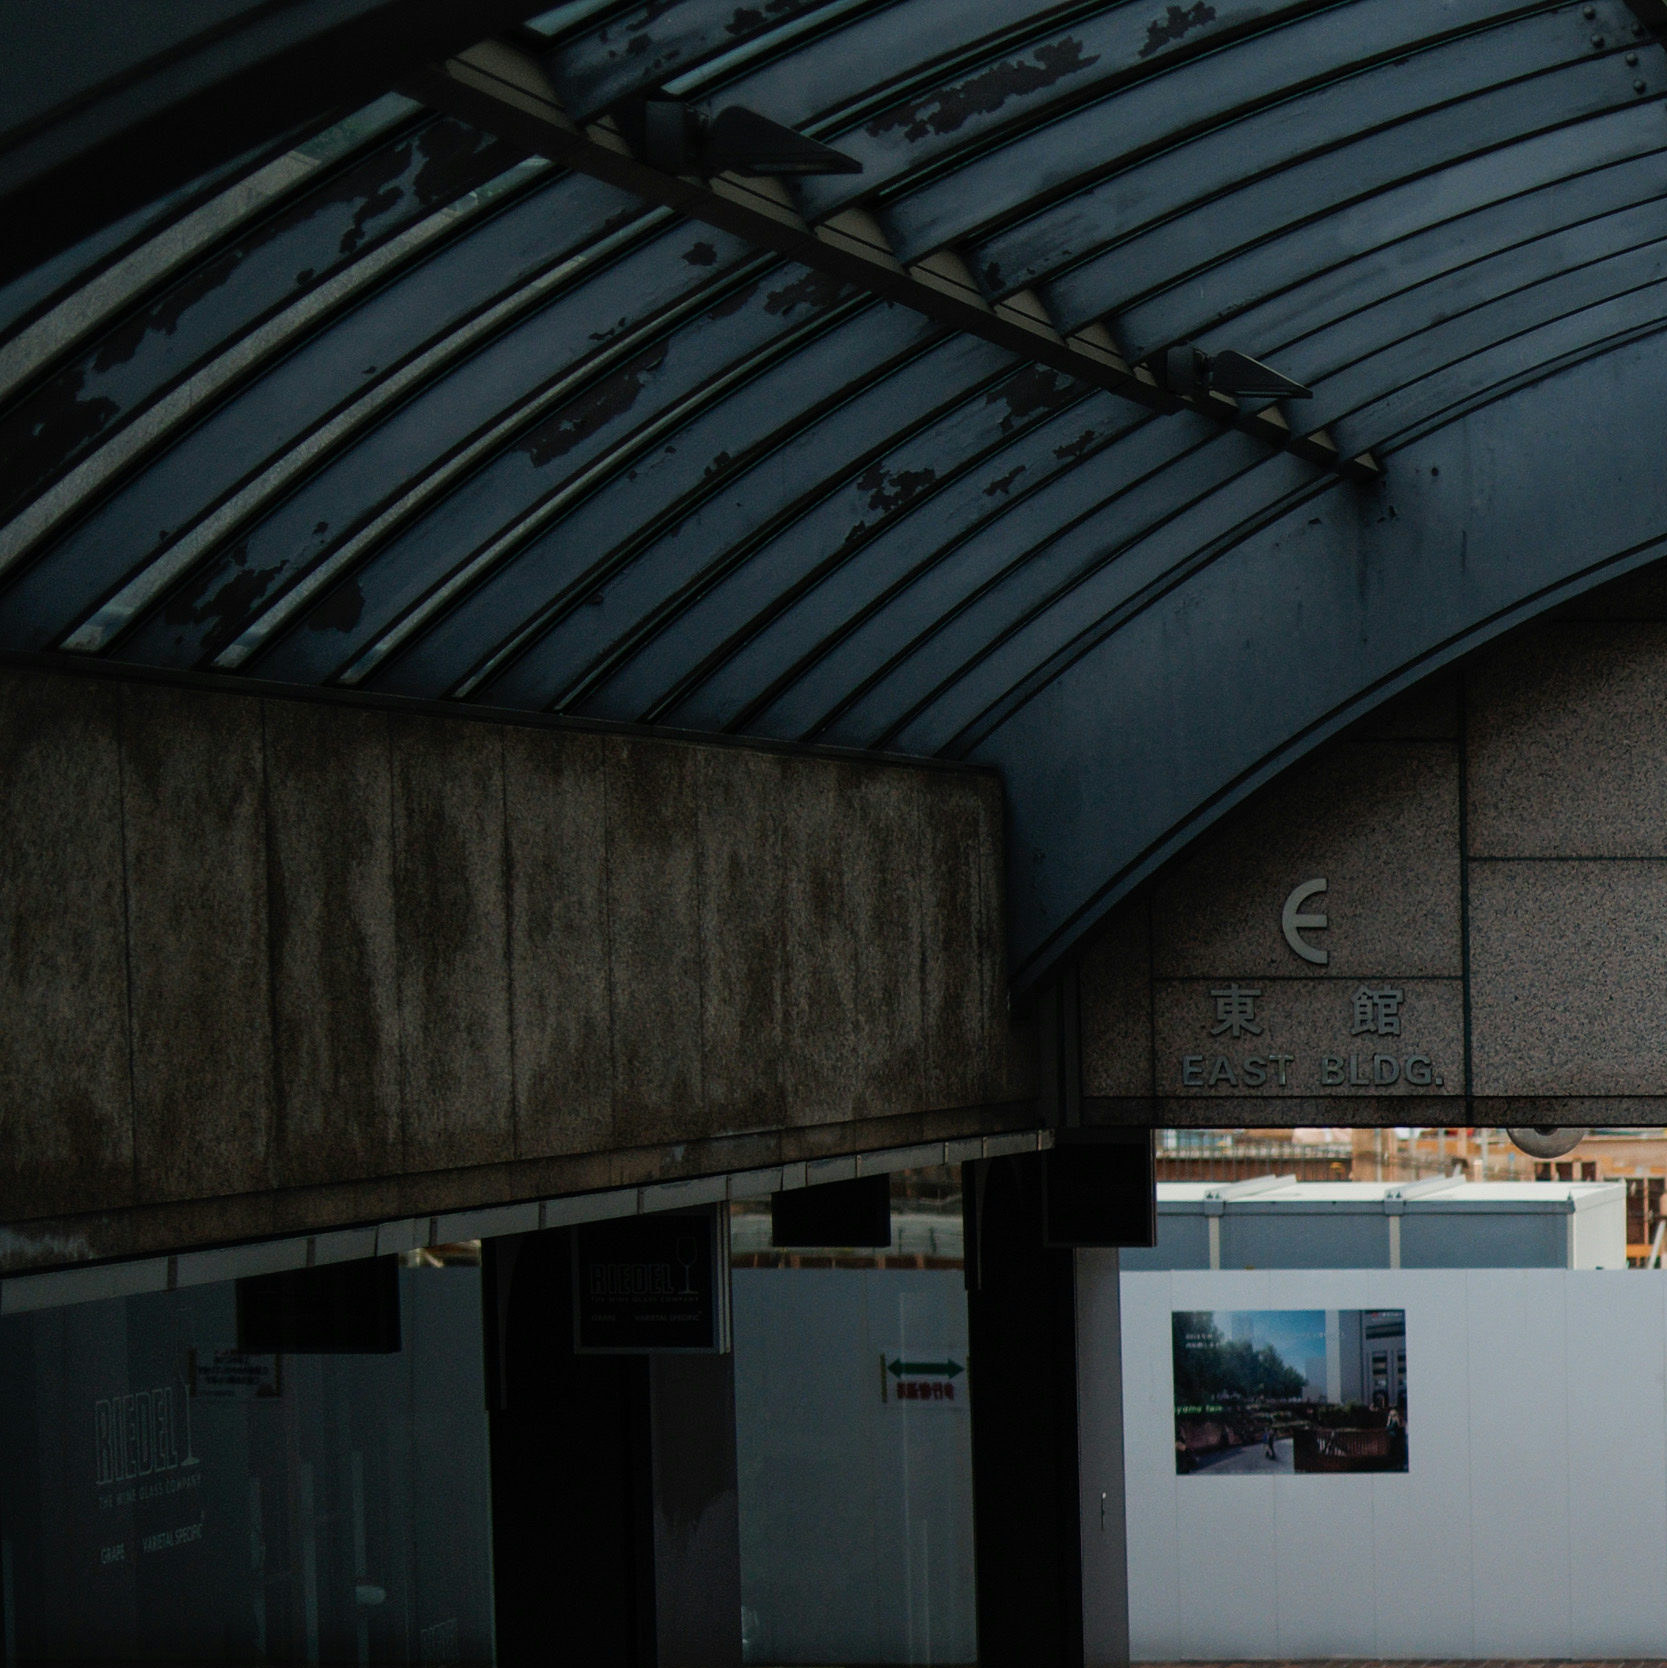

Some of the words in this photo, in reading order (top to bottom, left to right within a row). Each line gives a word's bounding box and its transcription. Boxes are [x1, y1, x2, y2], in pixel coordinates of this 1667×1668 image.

[1210, 983, 1404, 1038] 東館
[1181, 1053, 1294, 1088] EAST
[1320, 1053, 1444, 1087] BLDG.
[590, 1264, 676, 1295] RIEDEL
